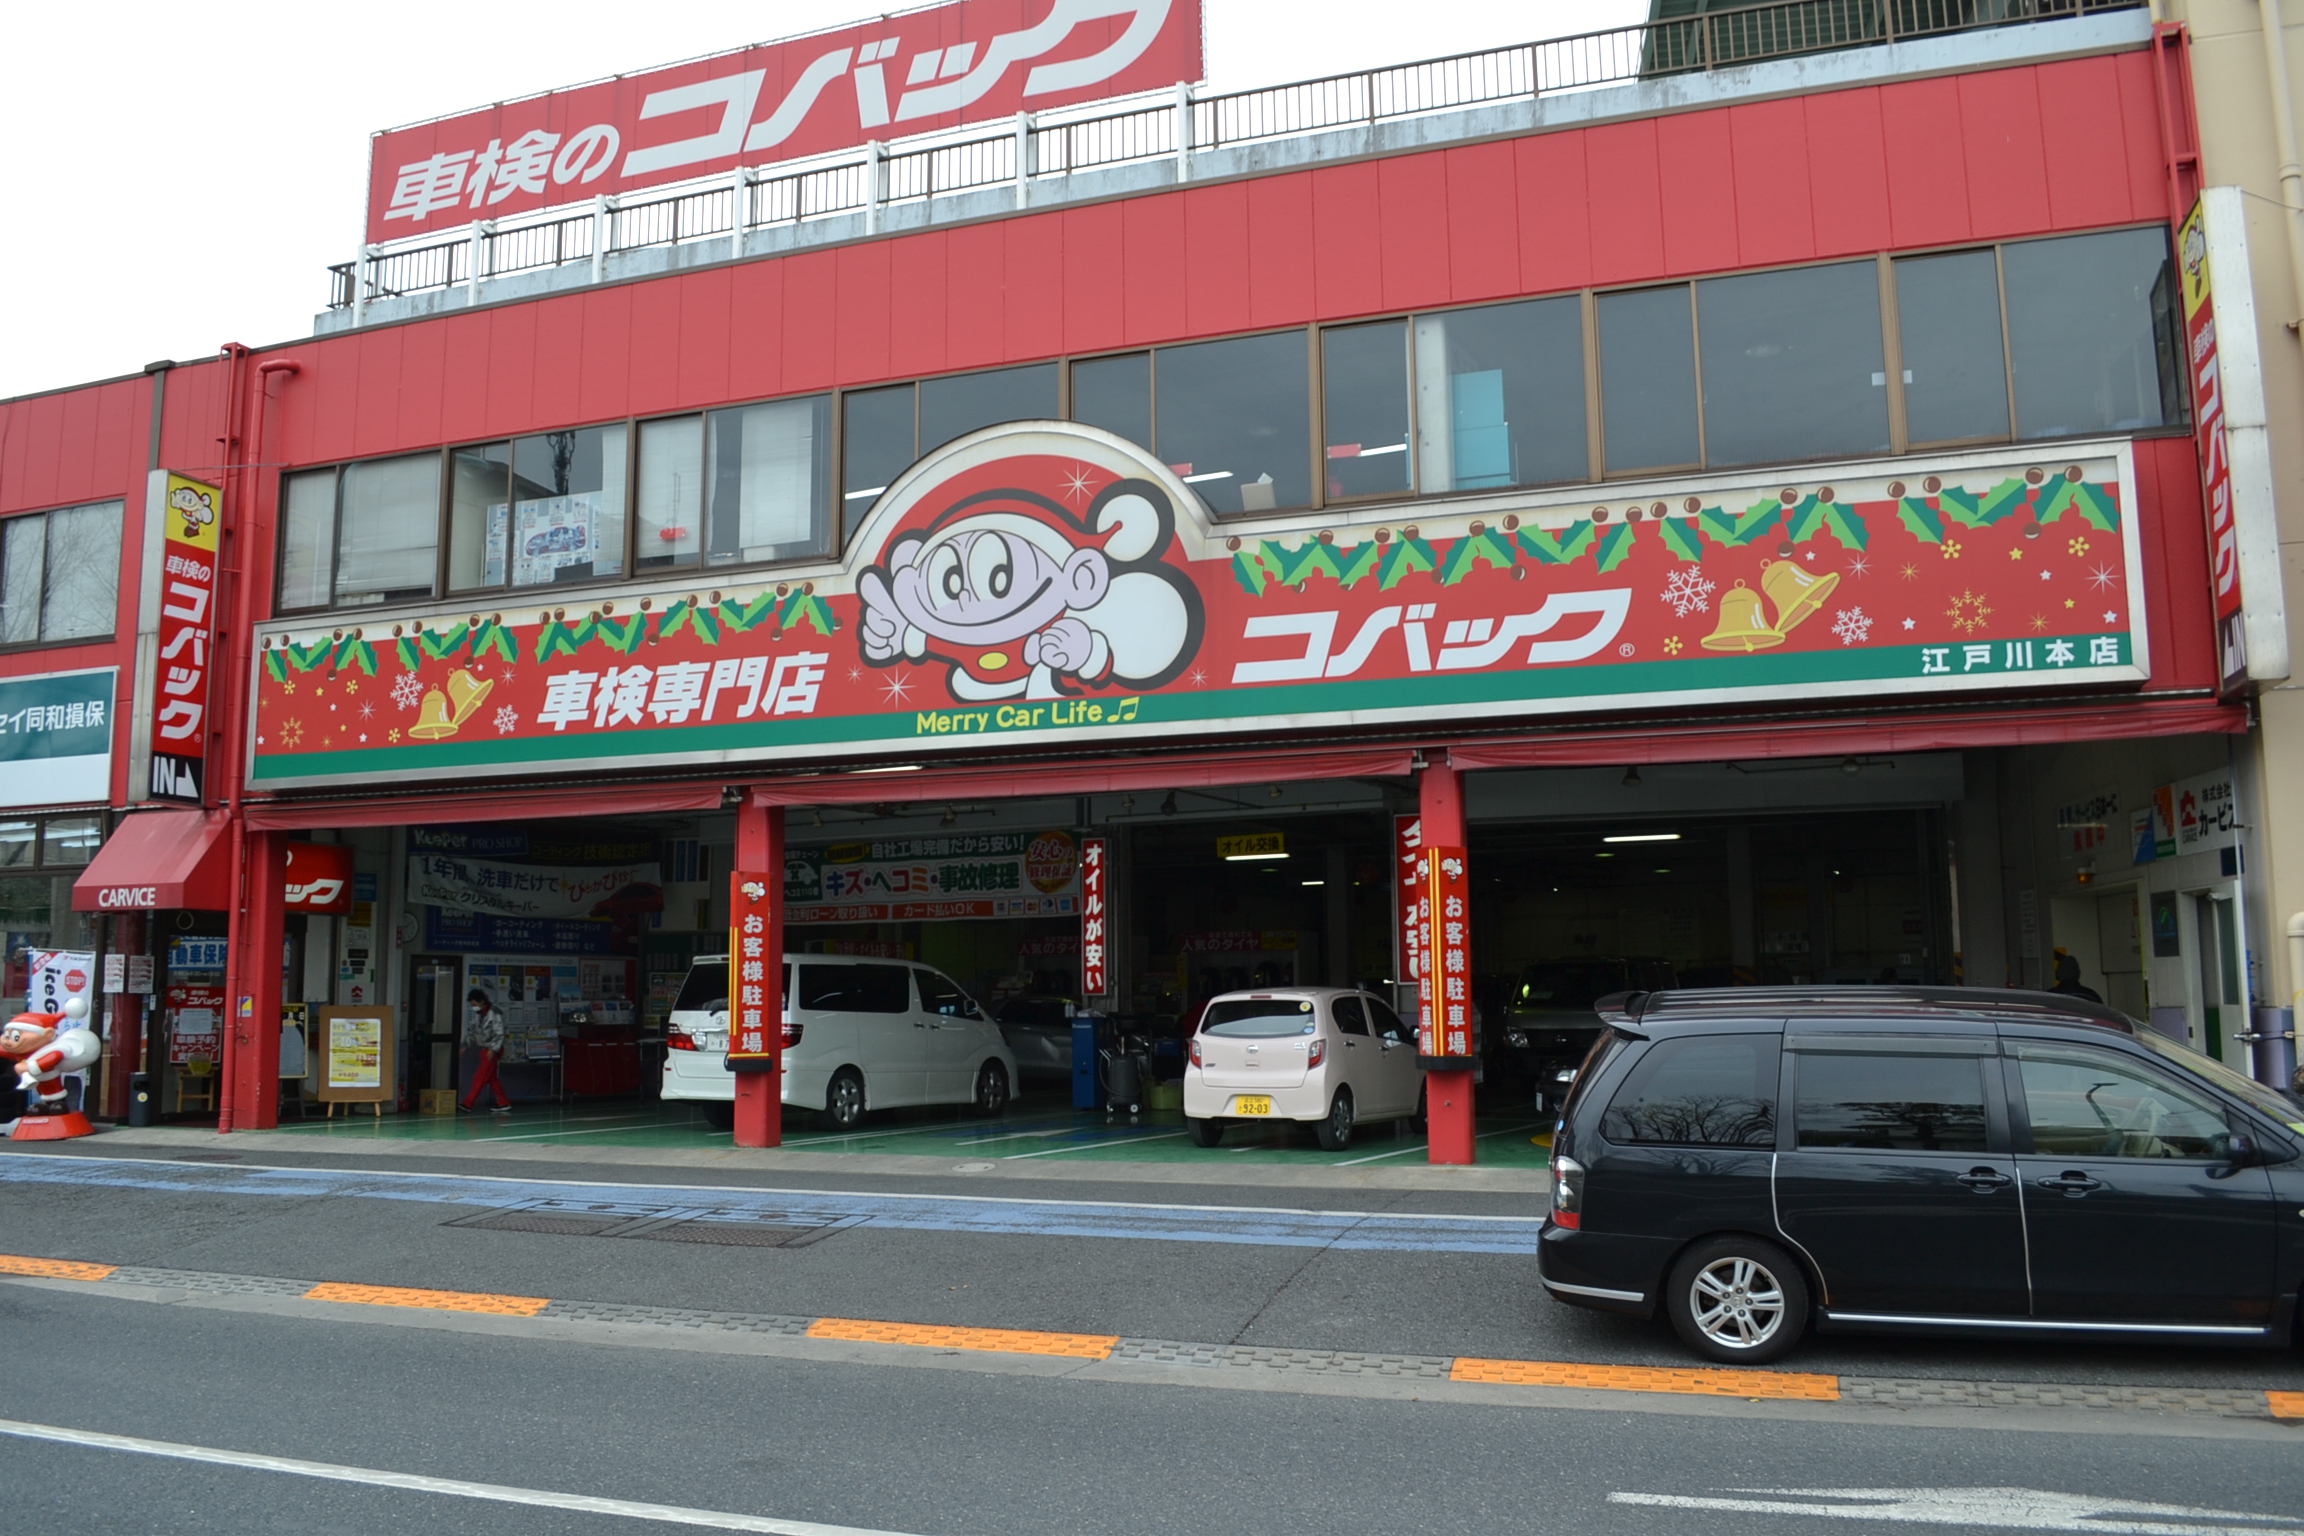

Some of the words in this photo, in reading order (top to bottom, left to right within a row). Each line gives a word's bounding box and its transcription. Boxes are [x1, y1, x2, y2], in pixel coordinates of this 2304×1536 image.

[2193, 317, 2214, 364] 車検の
[2200, 353, 2235, 598] コバック
[165, 554, 211, 582] 車検の
[1231, 587, 1632, 685] コバック
[159, 581, 210, 740] コバック
[1920, 637, 2121, 675] 江戸川本店
[537, 650, 829, 732] 車検専門店
[916, 708, 989, 735] Merry
[995, 703, 1044, 729] Car
[1051, 700, 1102, 725] Life
[152, 755, 176, 795] IN
[414, 829, 467, 849] KeePer
[472, 838, 495, 849] PRO
[496, 836, 523, 848] SHOP
[1029, 838, 1073, 861] 安心の
[1222, 836, 1280, 853] オイル交換
[825, 862, 1020, 897] キズ・ヘコミ・事故修理
[1029, 863, 1074, 878] 修理保証
[98, 886, 156, 907] CARVICE
[285, 878, 344, 904] ック
[903, 902, 975, 917] カード払いOK
[1085, 843, 1103, 991] オイルが安い
[1018, 942, 1081, 955] 人気のタイ
[1181, 938, 1259, 952] 人気のタイヤ
[65, 976, 86, 986] STOP!
[742, 913, 763, 1054] お客様駐車場
[1419, 896, 1433, 1056] お客様駐車場
[1445, 895, 1467, 1055] お客様駐車場
[187, 997, 224, 1005] コバック
[1243, 1103, 1268, 1114] 92-03
